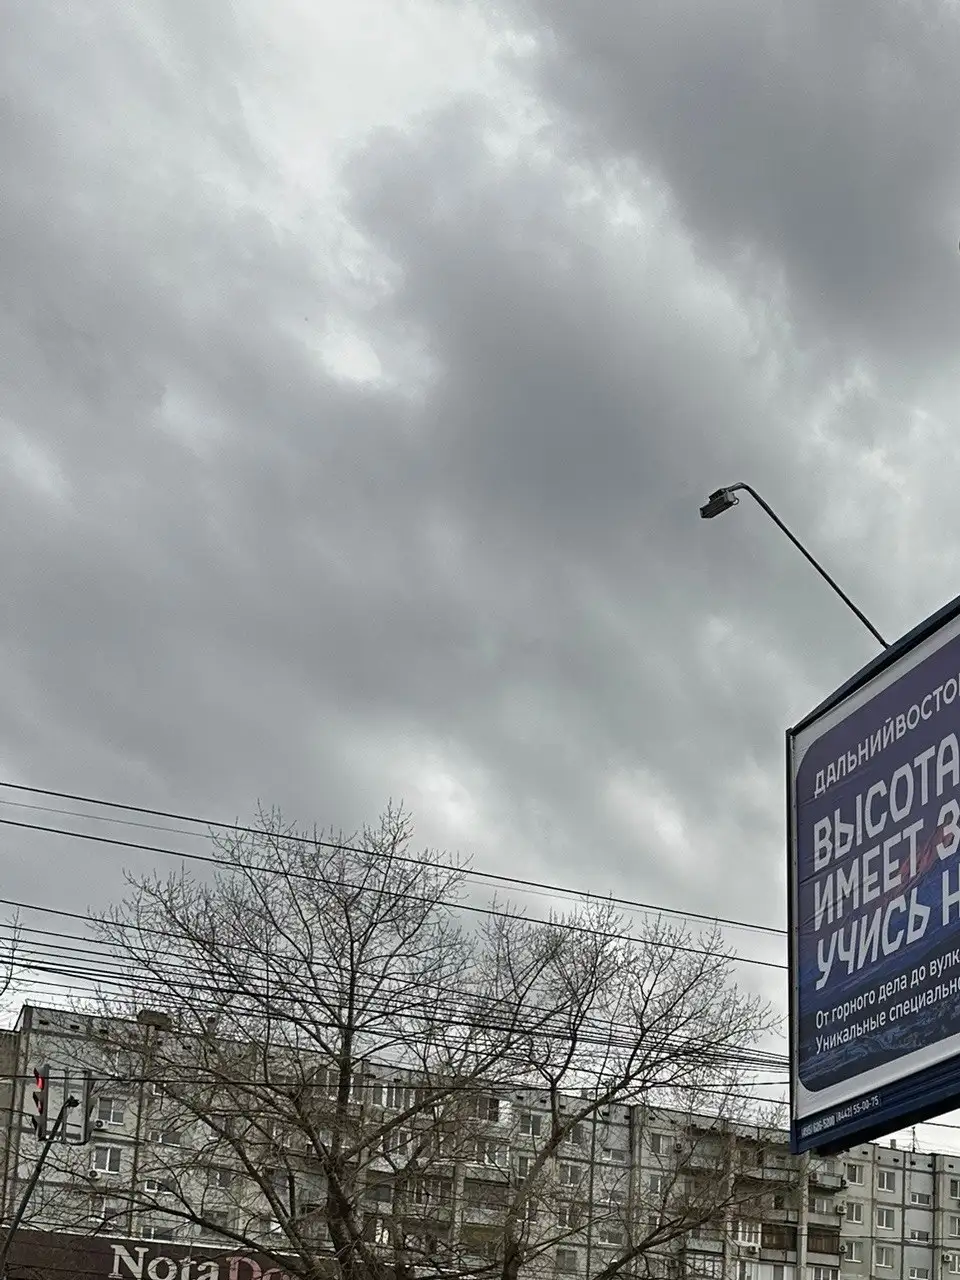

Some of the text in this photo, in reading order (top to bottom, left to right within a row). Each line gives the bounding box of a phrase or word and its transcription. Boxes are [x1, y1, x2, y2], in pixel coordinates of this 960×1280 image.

[814, 732, 960, 872] ВЫСОТА
[814, 818, 924, 931] ИМЕЕТ
[815, 888, 931, 990] УЧИСЬ
[815, 1009, 829, 1029] От
[831, 991, 876, 1025] горного
[878, 978, 908, 1006] дела
[910, 966, 928, 989] до
[815, 1010, 887, 1055] Уникальные
